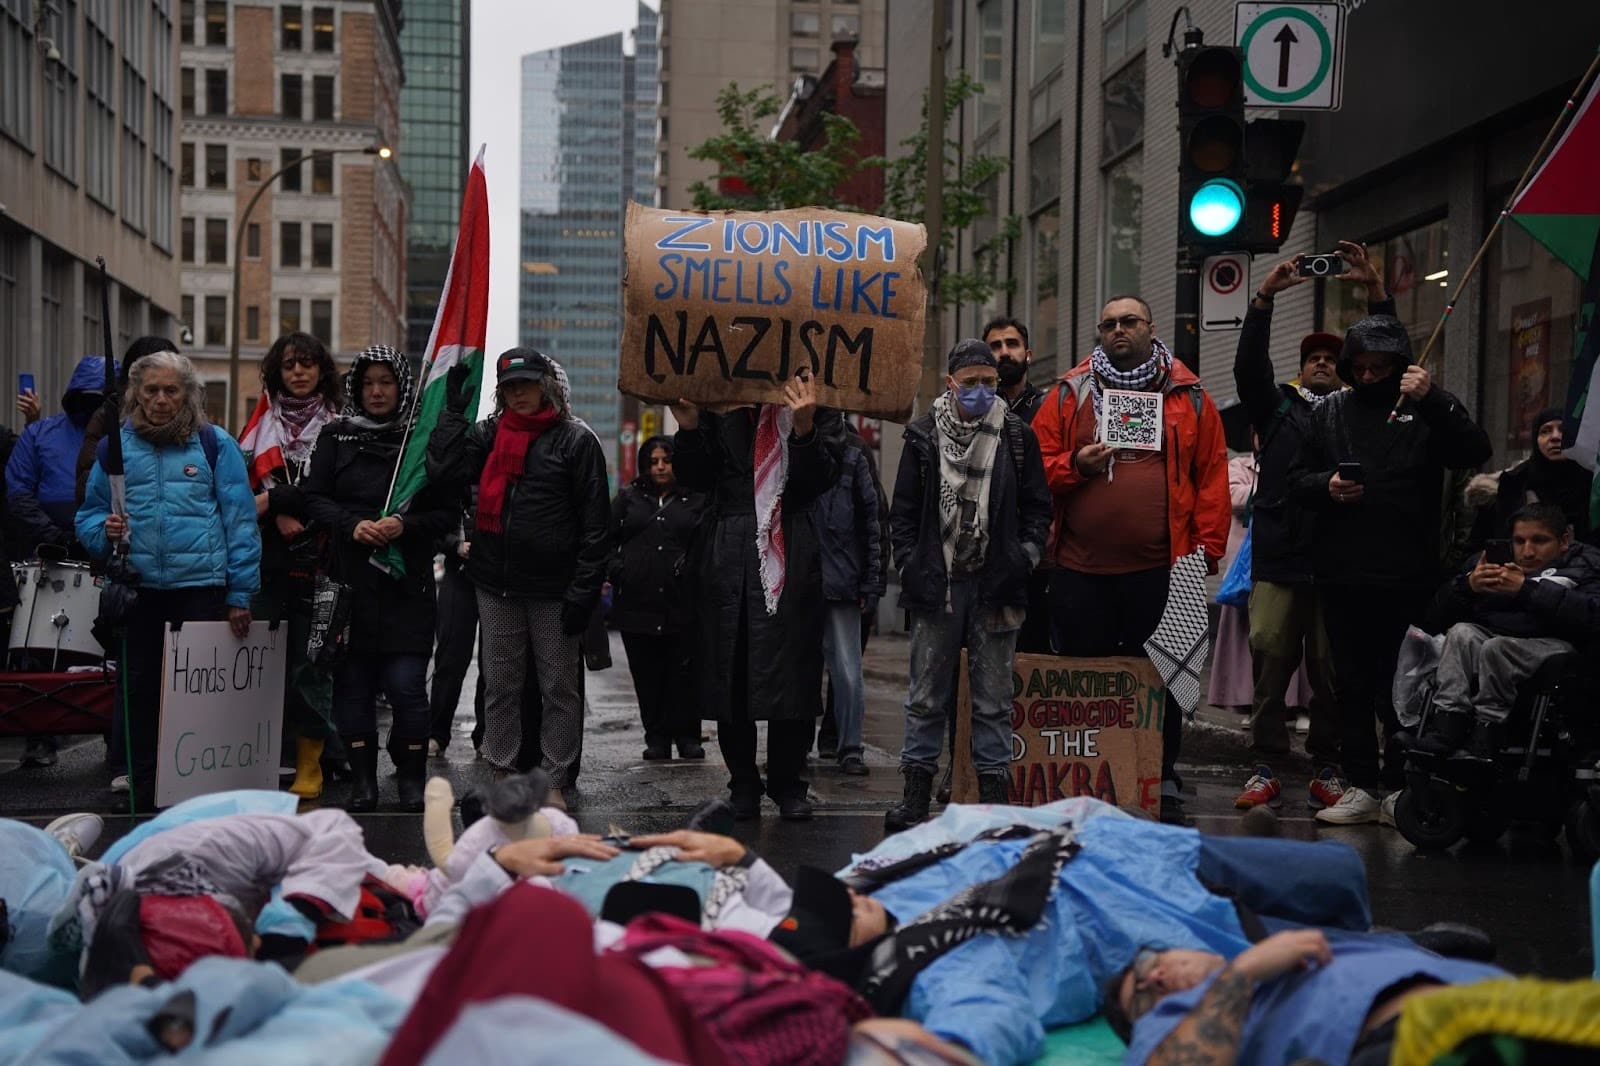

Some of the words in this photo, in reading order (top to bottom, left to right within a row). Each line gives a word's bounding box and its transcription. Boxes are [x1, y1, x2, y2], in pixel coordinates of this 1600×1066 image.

[656, 217, 896, 262] ZIONISM
[655, 254, 792, 305] SMELLS
[813, 265, 900, 318] LIKE
[645, 310, 873, 395] NAZISM
[173, 647, 226, 695] Hands
[232, 646, 269, 690] Off
[1026, 668, 1138, 698] APARTHEID
[1028, 698, 1135, 729] GENOCIDE
[175, 720, 271, 777] Gaza!!
[1040, 728, 1101, 758] THE
